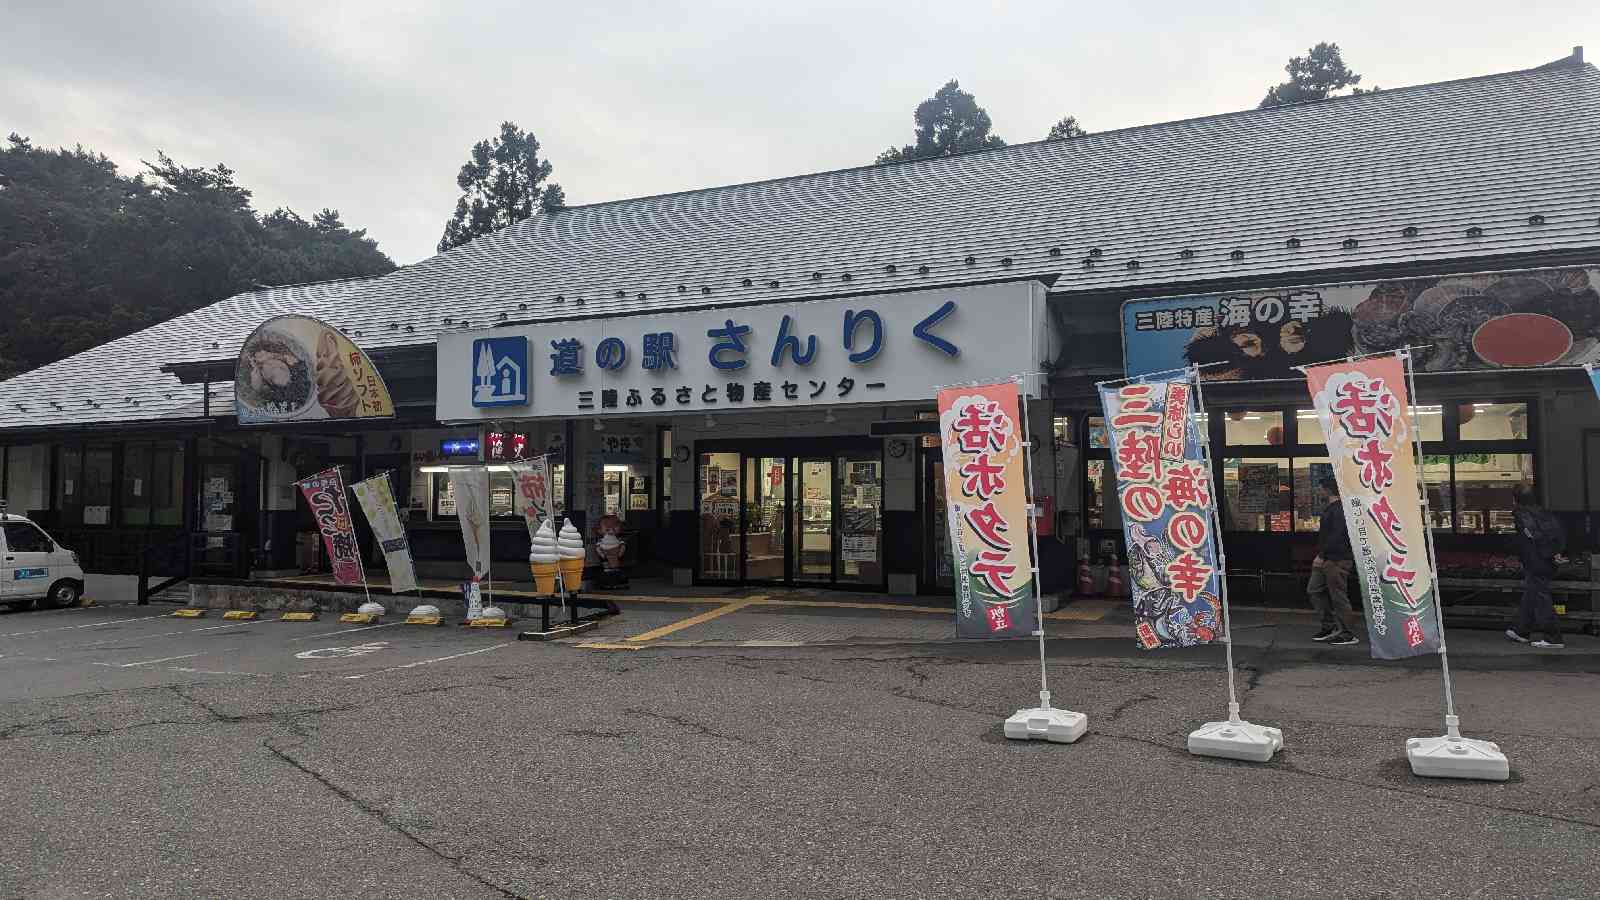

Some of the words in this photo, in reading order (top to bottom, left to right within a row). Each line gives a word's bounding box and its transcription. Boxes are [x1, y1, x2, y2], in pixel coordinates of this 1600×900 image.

[1136, 307, 1213, 330] 三陸特産
[1219, 291, 1323, 328] 海の幸
[550, 332, 678, 376] 道の駅
[706, 300, 960, 371] さんりく
[578, 377, 886, 409] 三陸ふるさと物産センター
